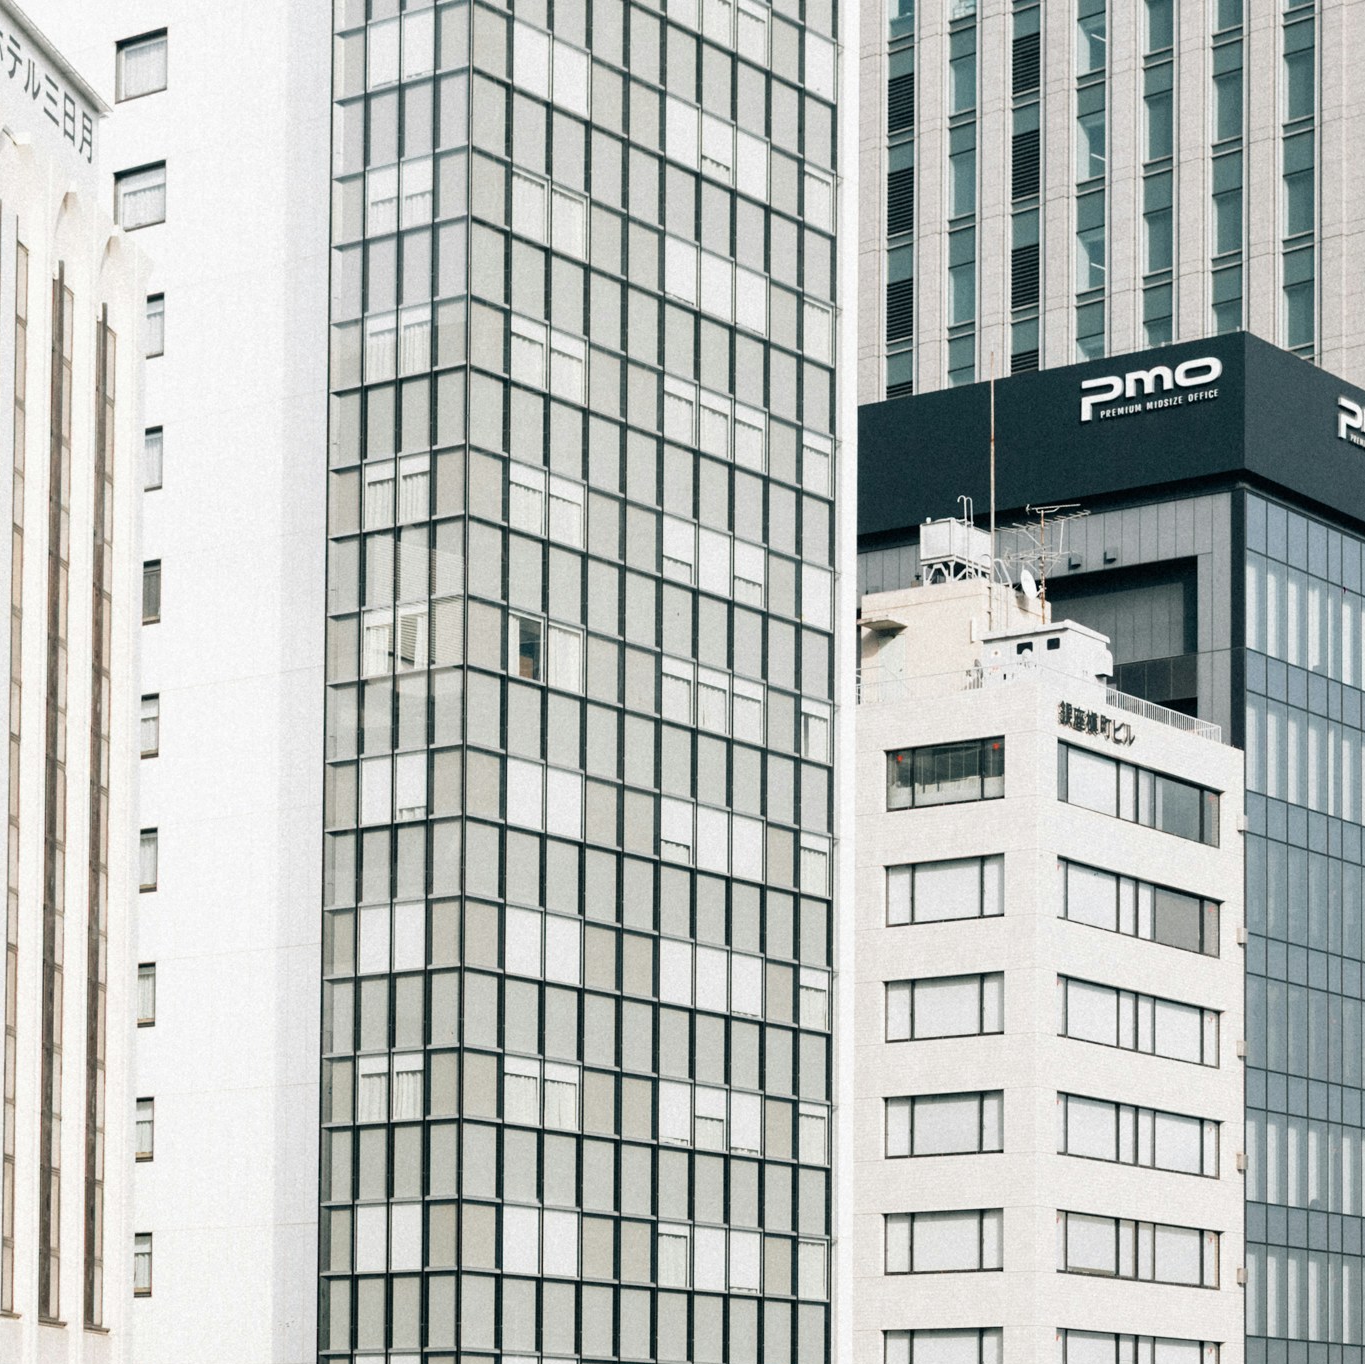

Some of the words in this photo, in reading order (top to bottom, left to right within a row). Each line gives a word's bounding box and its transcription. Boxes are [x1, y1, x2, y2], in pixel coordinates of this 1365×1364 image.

[1100, 403, 1142, 419] PREMIUM
[1146, 396, 1183, 411] MIDSIZE
[1188, 389, 1219, 403] OFFICE
